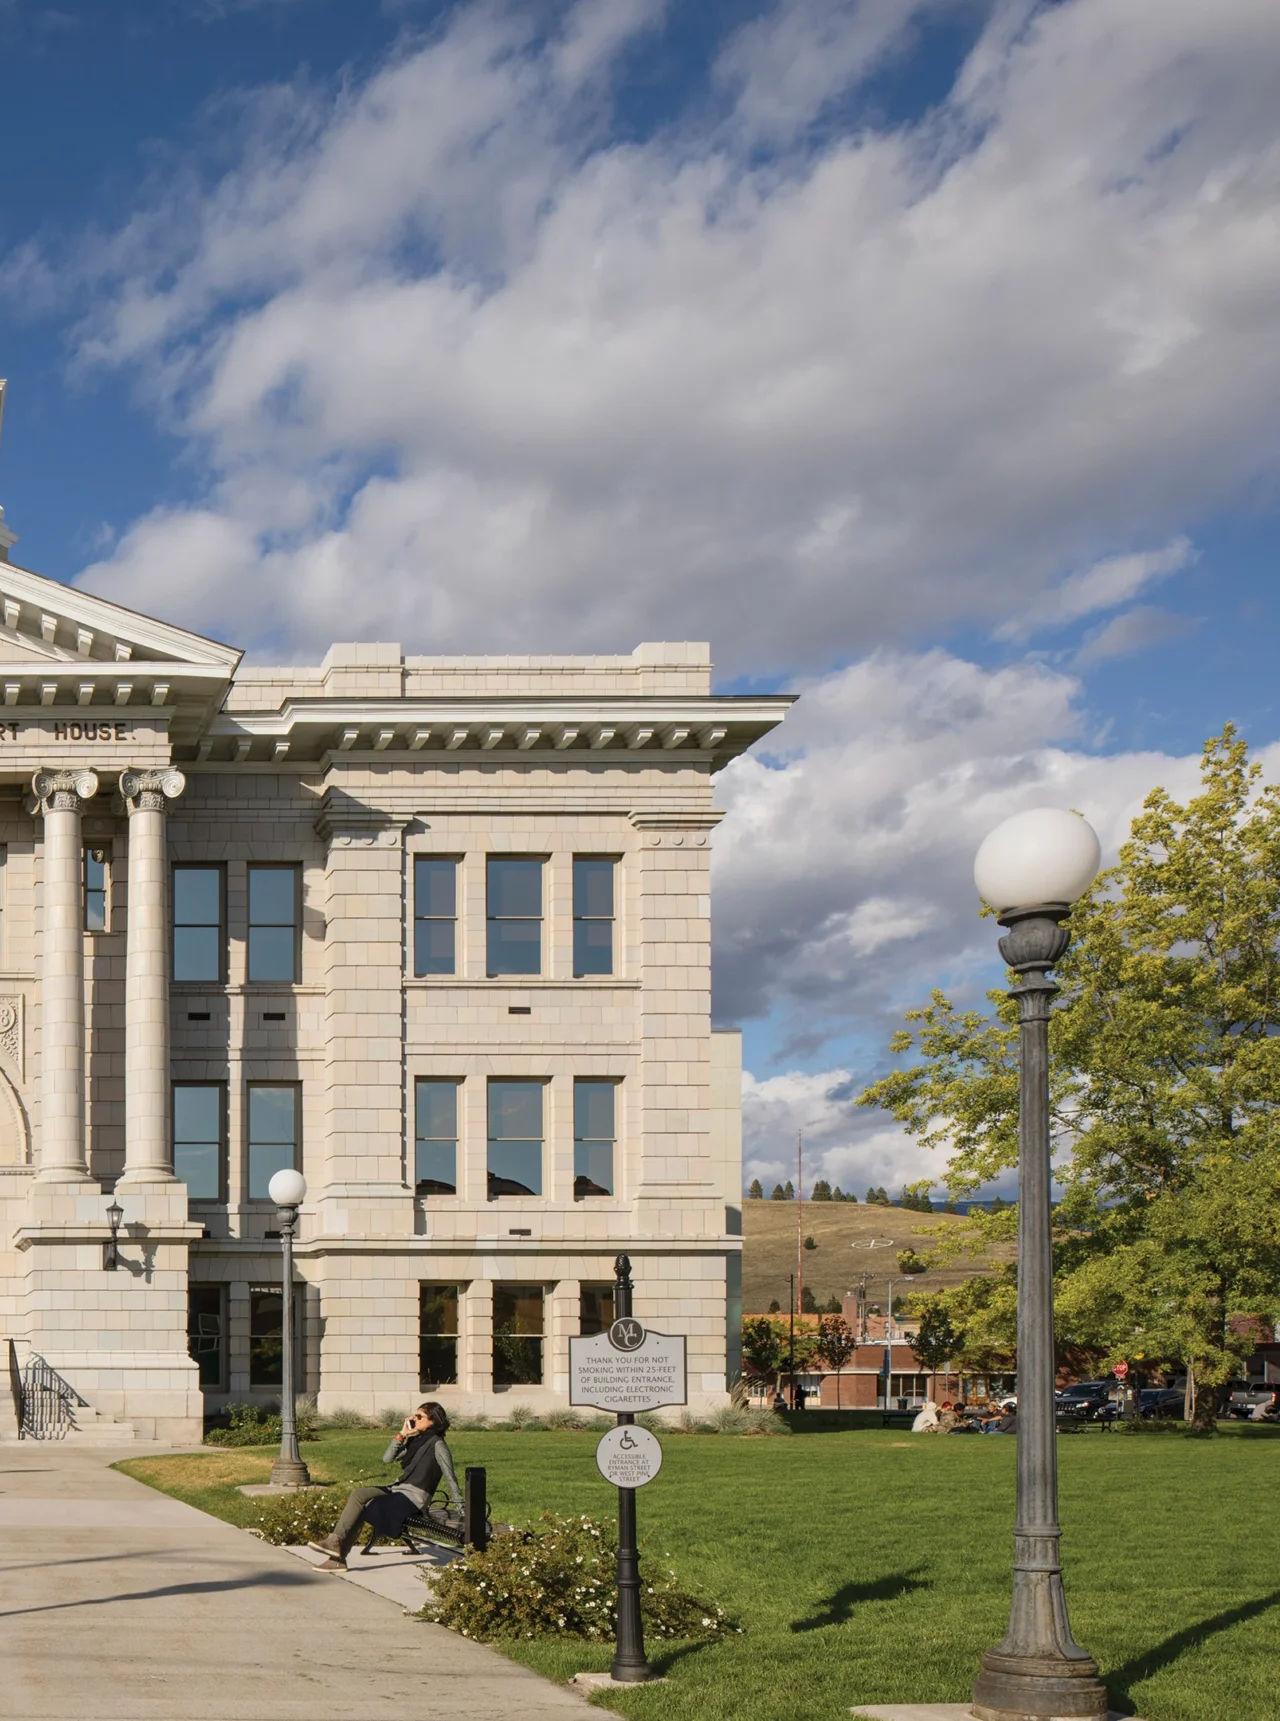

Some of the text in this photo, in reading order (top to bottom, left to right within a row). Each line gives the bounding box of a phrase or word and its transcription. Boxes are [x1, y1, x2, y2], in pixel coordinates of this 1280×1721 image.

[651, 1356, 669, 1364] NOT
[615, 1366, 644, 1374] WITHIN
[646, 1366, 676, 1374] 25-FEET
[580, 1376, 675, 1384] OF BUILDING ENTRANCE,
[626, 1385, 674, 1393] ELECTRONIC
[604, 1395, 651, 1403] CIGARETTES
